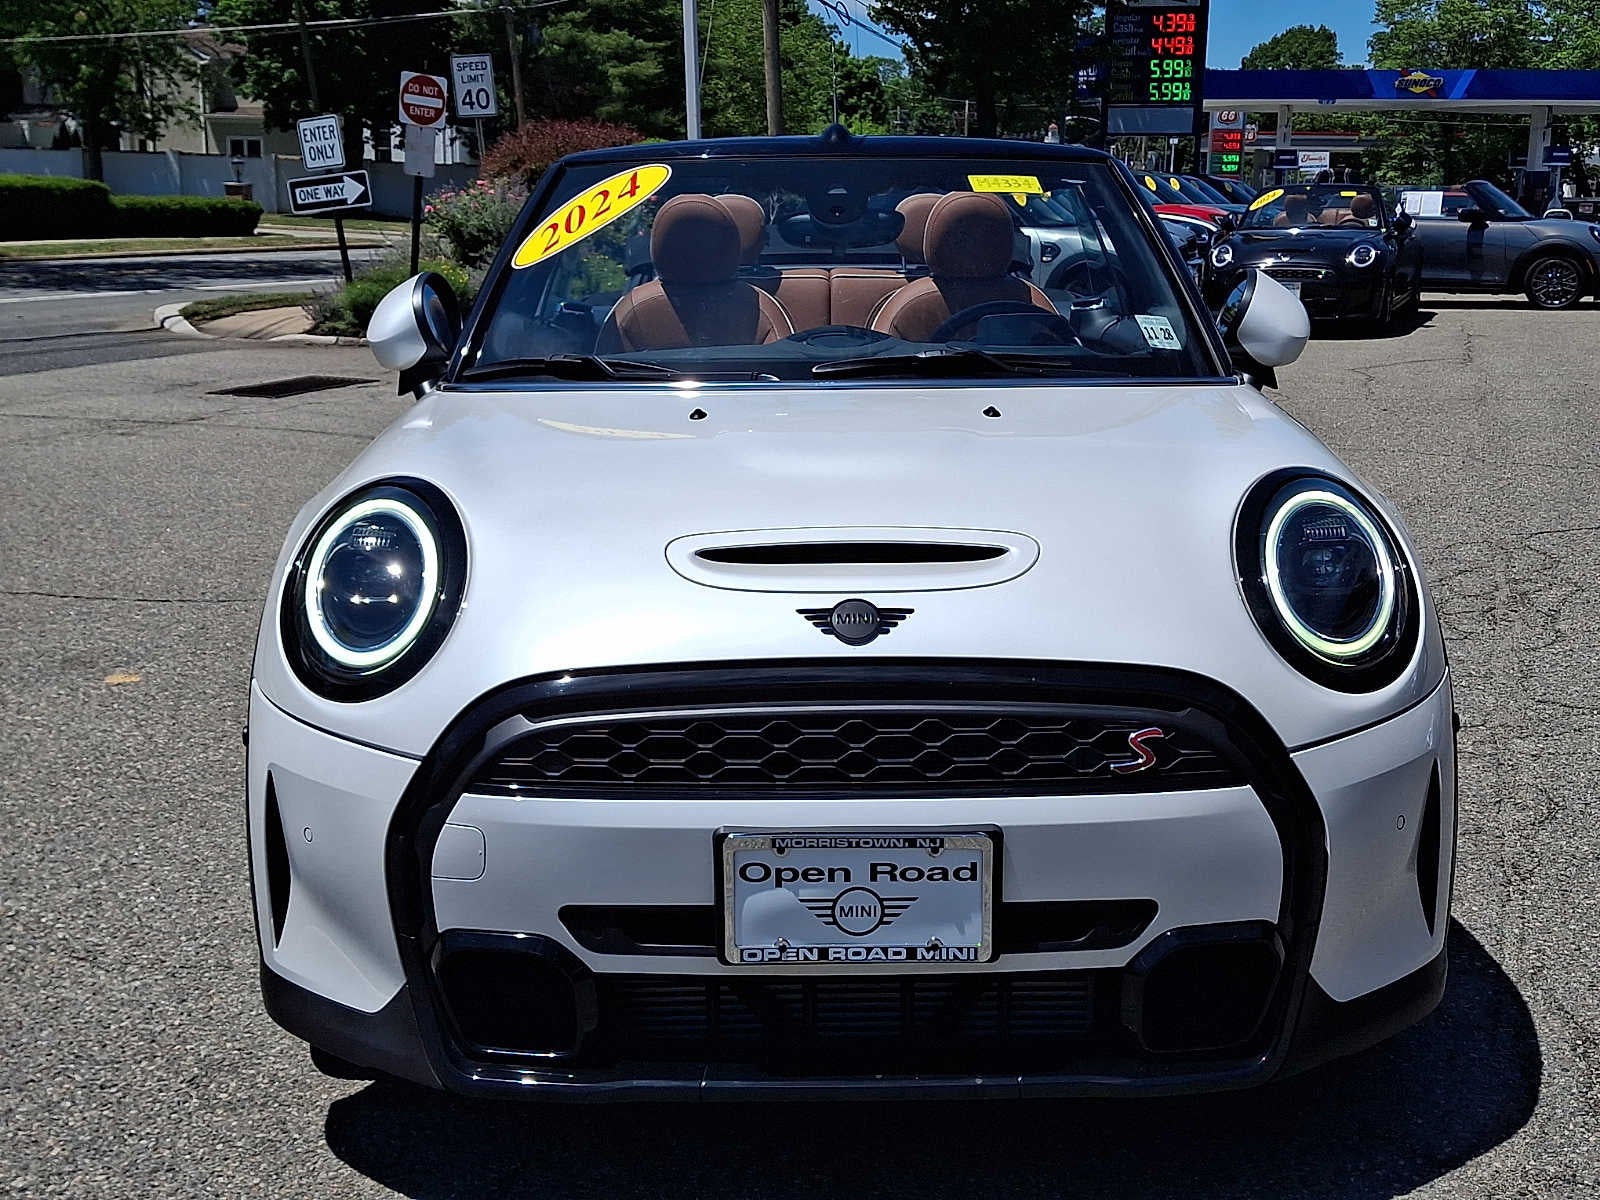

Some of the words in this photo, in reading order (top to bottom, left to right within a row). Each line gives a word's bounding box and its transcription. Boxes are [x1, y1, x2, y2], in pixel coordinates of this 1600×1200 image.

[1153, 13, 1187, 32] 4.39
[1151, 36, 1186, 55] 4.49
[456, 61, 488, 72] SPEED
[1150, 59, 1184, 78] 5.99
[461, 74, 485, 84] LIMIT
[1396, 78, 1442, 89] SUNOCO
[408, 83, 420, 93] DO
[422, 85, 439, 96] NOT
[1149, 82, 1183, 101] 5.99
[461, 87, 490, 110] 40
[409, 107, 436, 118] ENTER
[302, 124, 336, 143] ENTER
[308, 144, 336, 162] ONLY
[299, 188, 321, 202] ONE
[323, 185, 346, 199] WAY
[540, 171, 641, 254] 2024
[1143, 326, 1160, 341] 11
[1159, 327, 1175, 341] 28
[836, 613, 874, 625] MINI
[1110, 726, 1164, 774] S
[916, 837, 941, 848] NJ
[738, 861, 852, 888] Open
[868, 861, 979, 883] Road
[838, 904, 878, 918] MINI
[742, 947, 819, 963] OPEN
[828, 947, 906, 962] ROAD
[915, 947, 976, 961] MINI
